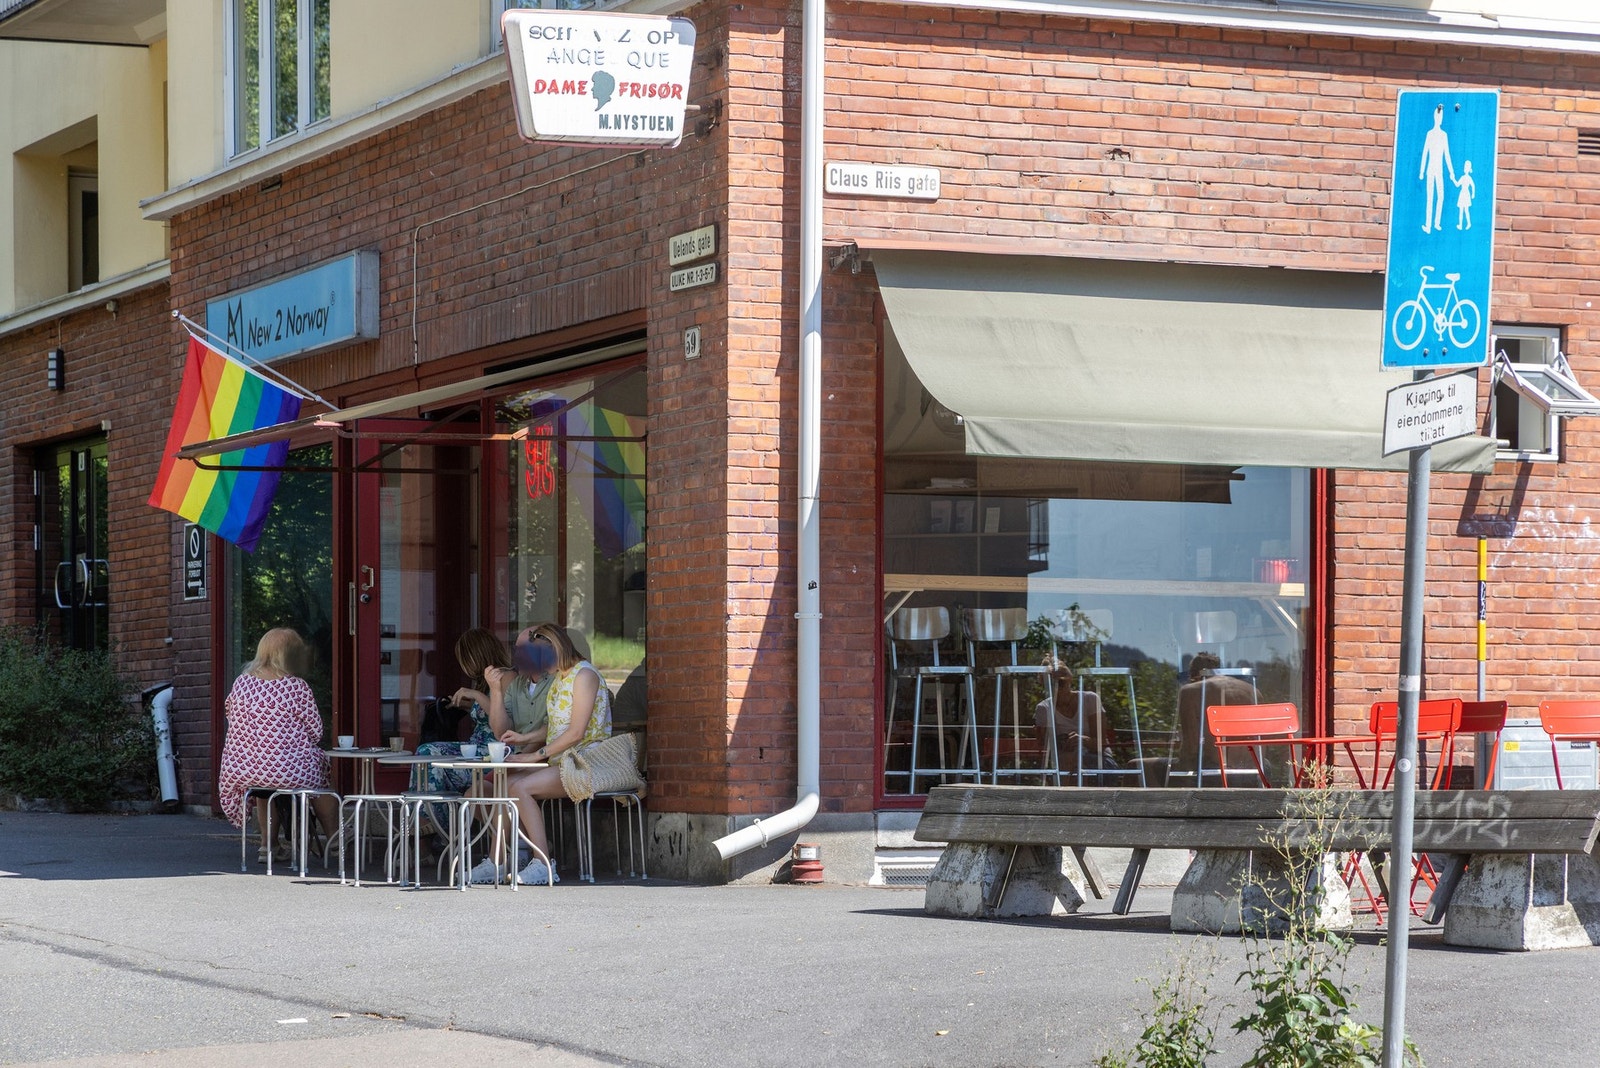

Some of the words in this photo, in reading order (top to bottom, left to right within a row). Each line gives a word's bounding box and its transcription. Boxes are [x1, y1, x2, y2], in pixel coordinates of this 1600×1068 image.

[547, 48, 670, 69] ANGEQUE
[533, 79, 588, 96] DAME
[619, 81, 683, 100] FRISØR
[599, 114, 674, 132] M.NYSTUEN
[830, 168, 868, 188] Claus
[875, 170, 901, 190] Riis
[908, 174, 937, 195] gate
[673, 236, 695, 259] Uelands
[698, 233, 711, 256] gate
[248, 317, 272, 350] New
[274, 309, 283, 341] 2
[686, 331, 696, 355] 59
[1406, 388, 1442, 408] Kjøring
[1448, 384, 1456, 397] til
[1397, 404, 1463, 429] eiendommene
